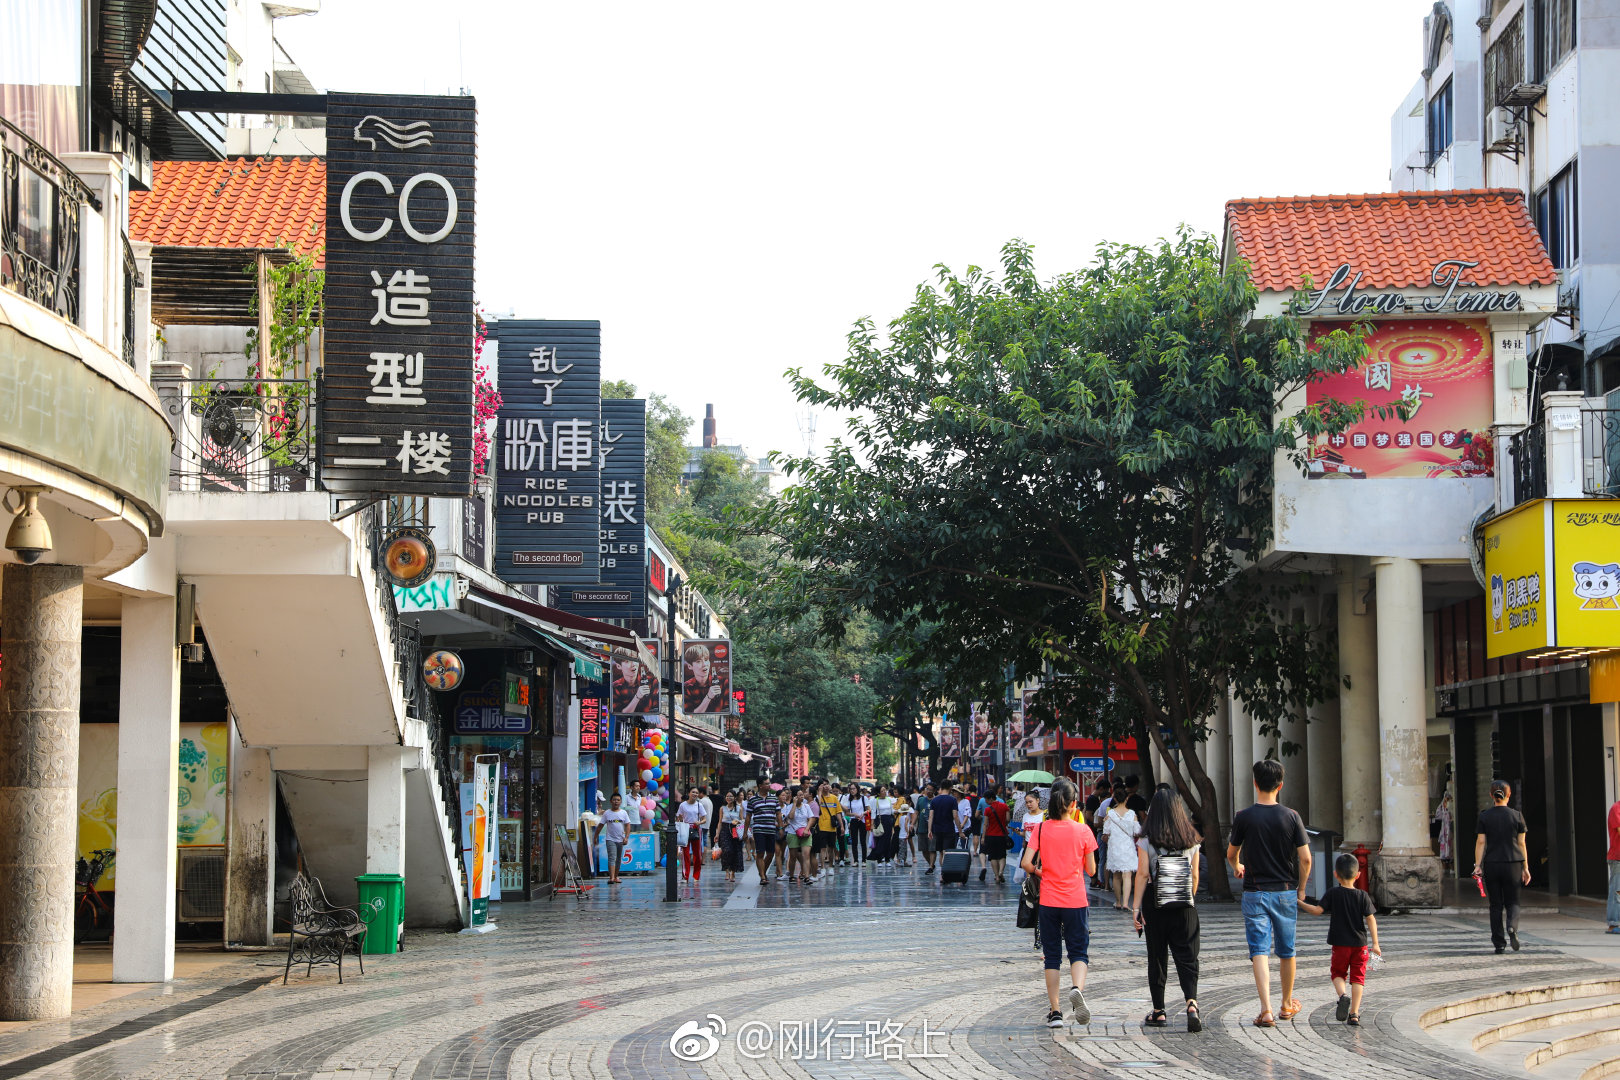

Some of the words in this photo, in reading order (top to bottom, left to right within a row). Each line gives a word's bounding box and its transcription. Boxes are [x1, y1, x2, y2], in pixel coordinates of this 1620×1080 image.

[340, 171, 458, 243] CO
[1296, 262, 1406, 314] Slow
[1423, 259, 1522, 312] Time
[365, 269, 432, 406] 造型
[1501, 339, 1524, 349] 转让
[528, 345, 574, 406] 乱了
[504, 417, 593, 472] 粉庫
[1331, 432, 1456, 447] 中国梦强国梦
[333, 429, 452, 475] 二楼
[525, 478, 568, 490] RICE
[504, 494, 593, 508] NOODLES
[603, 480, 638, 524] 装
[527, 511, 564, 524] PUB
[600, 529, 617, 540] CE
[600, 543, 639, 554] DLES
[514, 553, 530, 562] The
[532, 553, 561, 562] second
[563, 553, 581, 562] floor
[574, 592, 587, 600] The
[588, 592, 613, 600] second
[614, 592, 629, 600] floor
[1506, 572, 1541, 611] 周黑鸭
[635, 861, 653, 870] 元起
